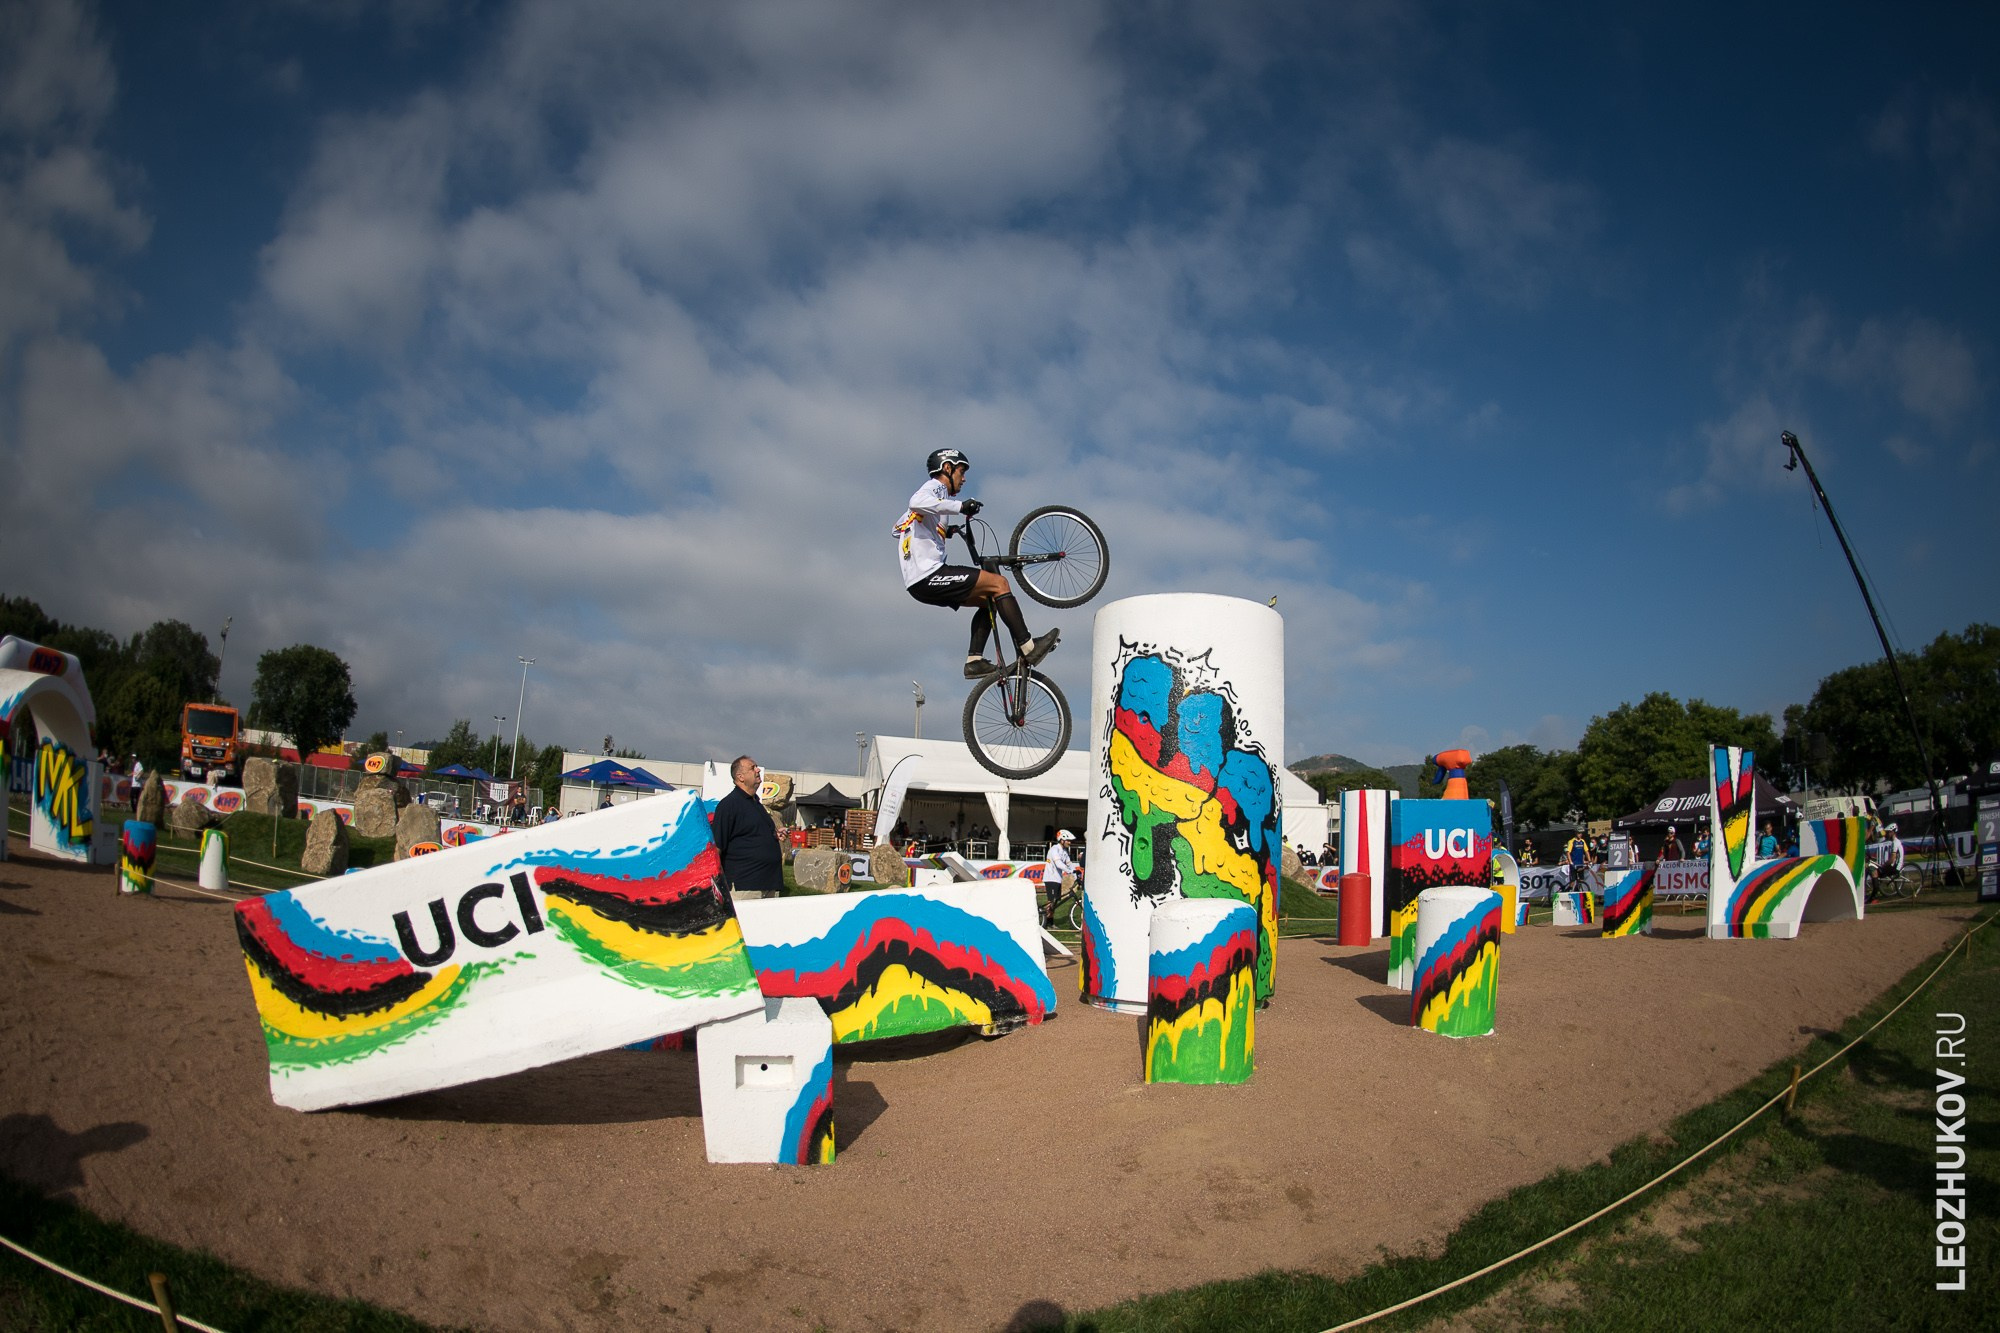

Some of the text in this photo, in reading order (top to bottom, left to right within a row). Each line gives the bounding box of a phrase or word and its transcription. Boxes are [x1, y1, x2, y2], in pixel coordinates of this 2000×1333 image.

[1424, 828, 1475, 860] UCI
[1985, 821, 1995, 841] 2
[1613, 850, 1623, 866] 2
[392, 871, 546, 968] UCI
